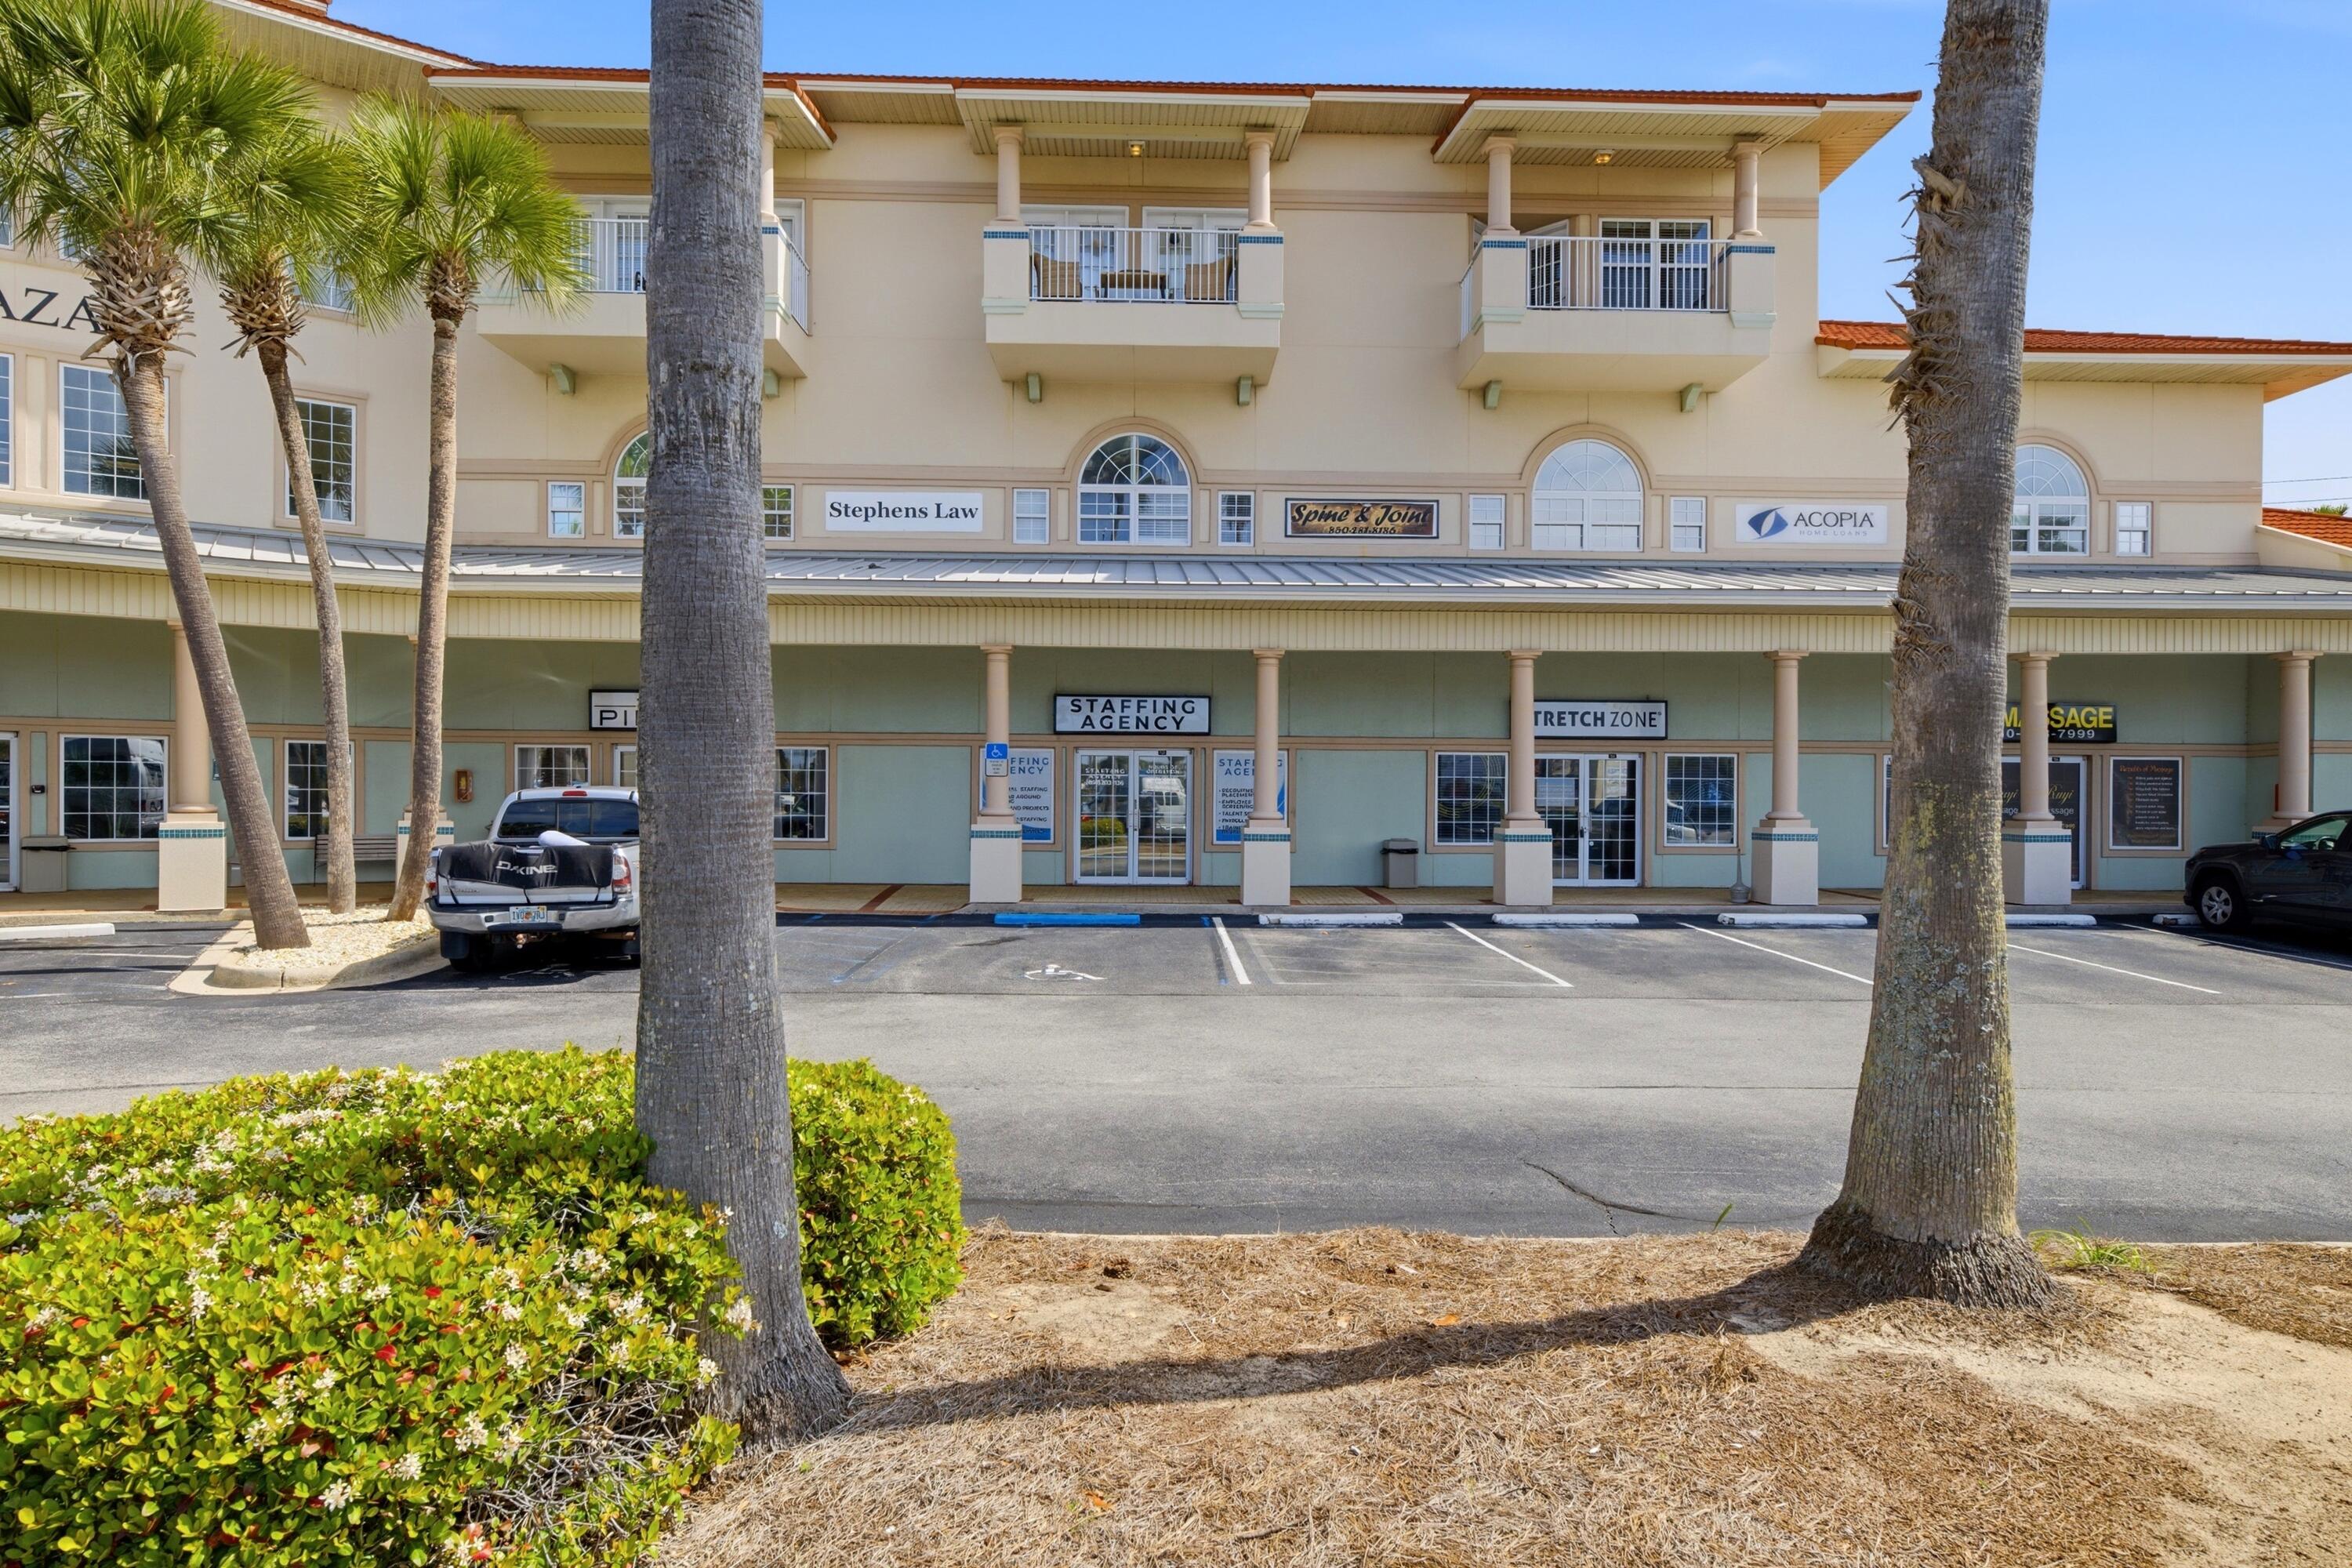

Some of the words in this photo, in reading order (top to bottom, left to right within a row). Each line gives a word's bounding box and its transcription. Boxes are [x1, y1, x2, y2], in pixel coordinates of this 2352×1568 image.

[829, 501, 928, 522] Stephens
[935, 503, 979, 519] Law
[1292, 504, 1350, 526] Spine
[1355, 504, 1372, 523] &
[1375, 505, 1432, 526] Joint
[1794, 512, 1874, 528] ACOPIA
[1070, 699, 1196, 714] STAFFING
[600, 710, 638, 726] PI
[1080, 715, 1185, 730] AGENCY
[1534, 710, 1605, 727] TRETCH
[2004, 706, 2114, 728] MSAGE
[1011, 757, 1049, 766] FFING
[1010, 766, 1044, 775] ENCY
[1225, 768, 1254, 776] AGE
[2051, 808, 2074, 816] ssage
